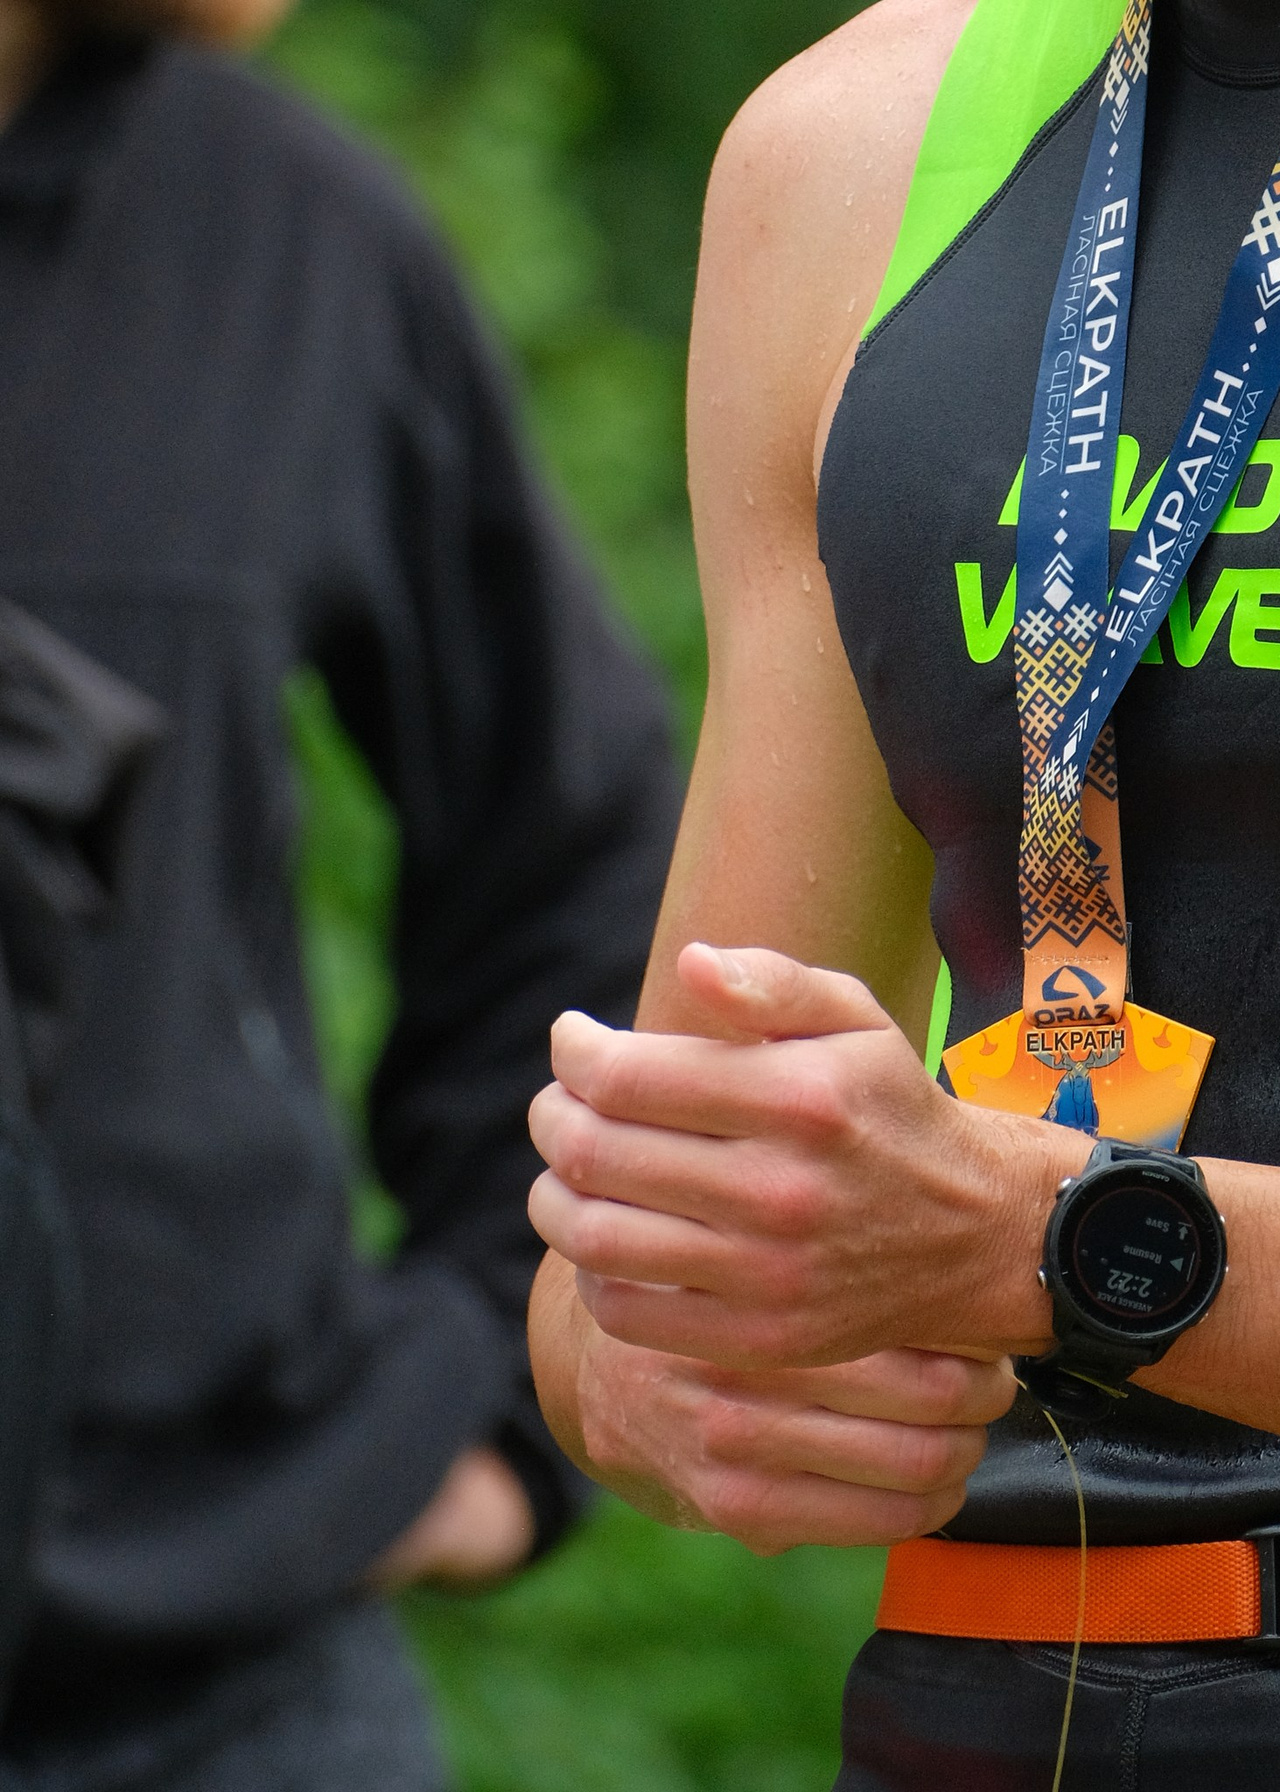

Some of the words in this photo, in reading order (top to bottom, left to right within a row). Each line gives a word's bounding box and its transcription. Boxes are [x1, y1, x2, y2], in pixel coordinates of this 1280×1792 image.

[1060, 215, 1095, 341] ЛАСІНАЯ
[1065, 197, 1128, 474] ELKPATH
[1039, 350, 1072, 476] СЦЕЖКА
[1105, 369, 1244, 642] ELKPATH
[1127, 520, 1201, 647] ЛАСІНАЯ
[1199, 389, 1263, 512] СЦЕЖКА
[1026, 1029, 1125, 1052] ELKPATH
[1034, 1004, 1110, 1026] ORAZ
[1123, 1245, 1161, 1264] Resume
[1145, 1218, 1169, 1232] Save
[1107, 1269, 1152, 1297] 2:22
